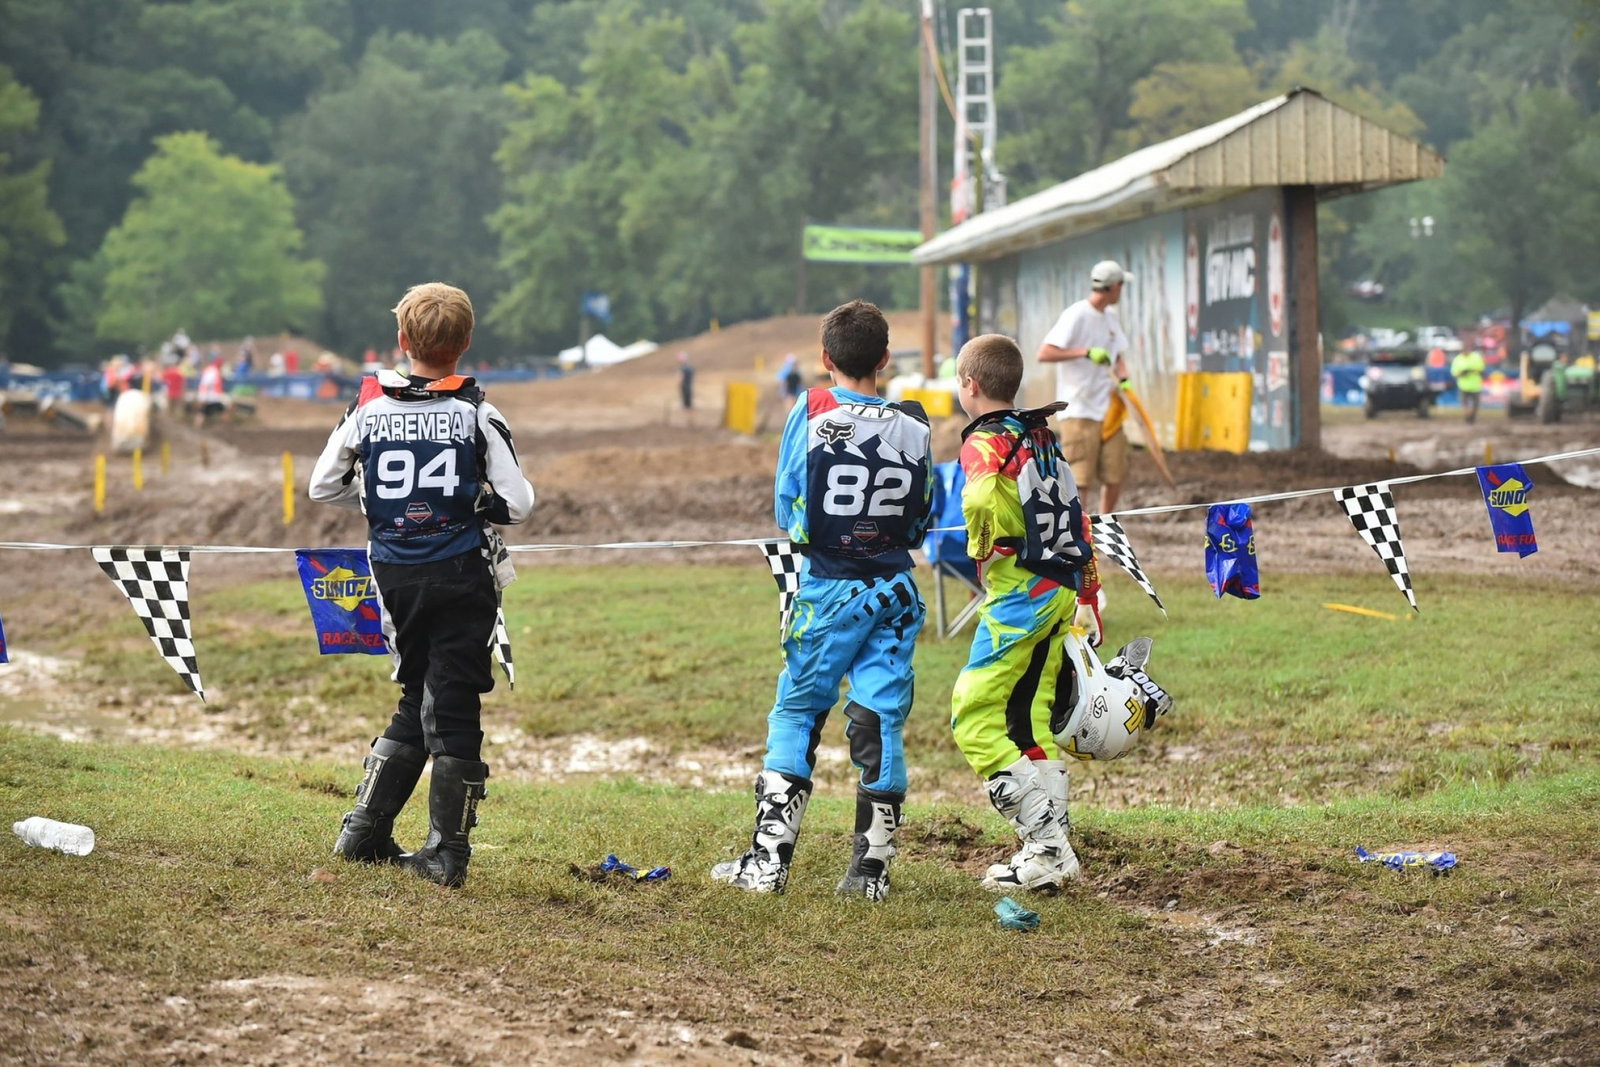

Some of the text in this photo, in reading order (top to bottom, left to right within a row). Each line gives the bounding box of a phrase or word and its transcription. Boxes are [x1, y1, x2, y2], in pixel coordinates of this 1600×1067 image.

[365, 412, 465, 442] ZAREMBA
[376, 448, 460, 499] 94
[823, 464, 912, 516] 82
